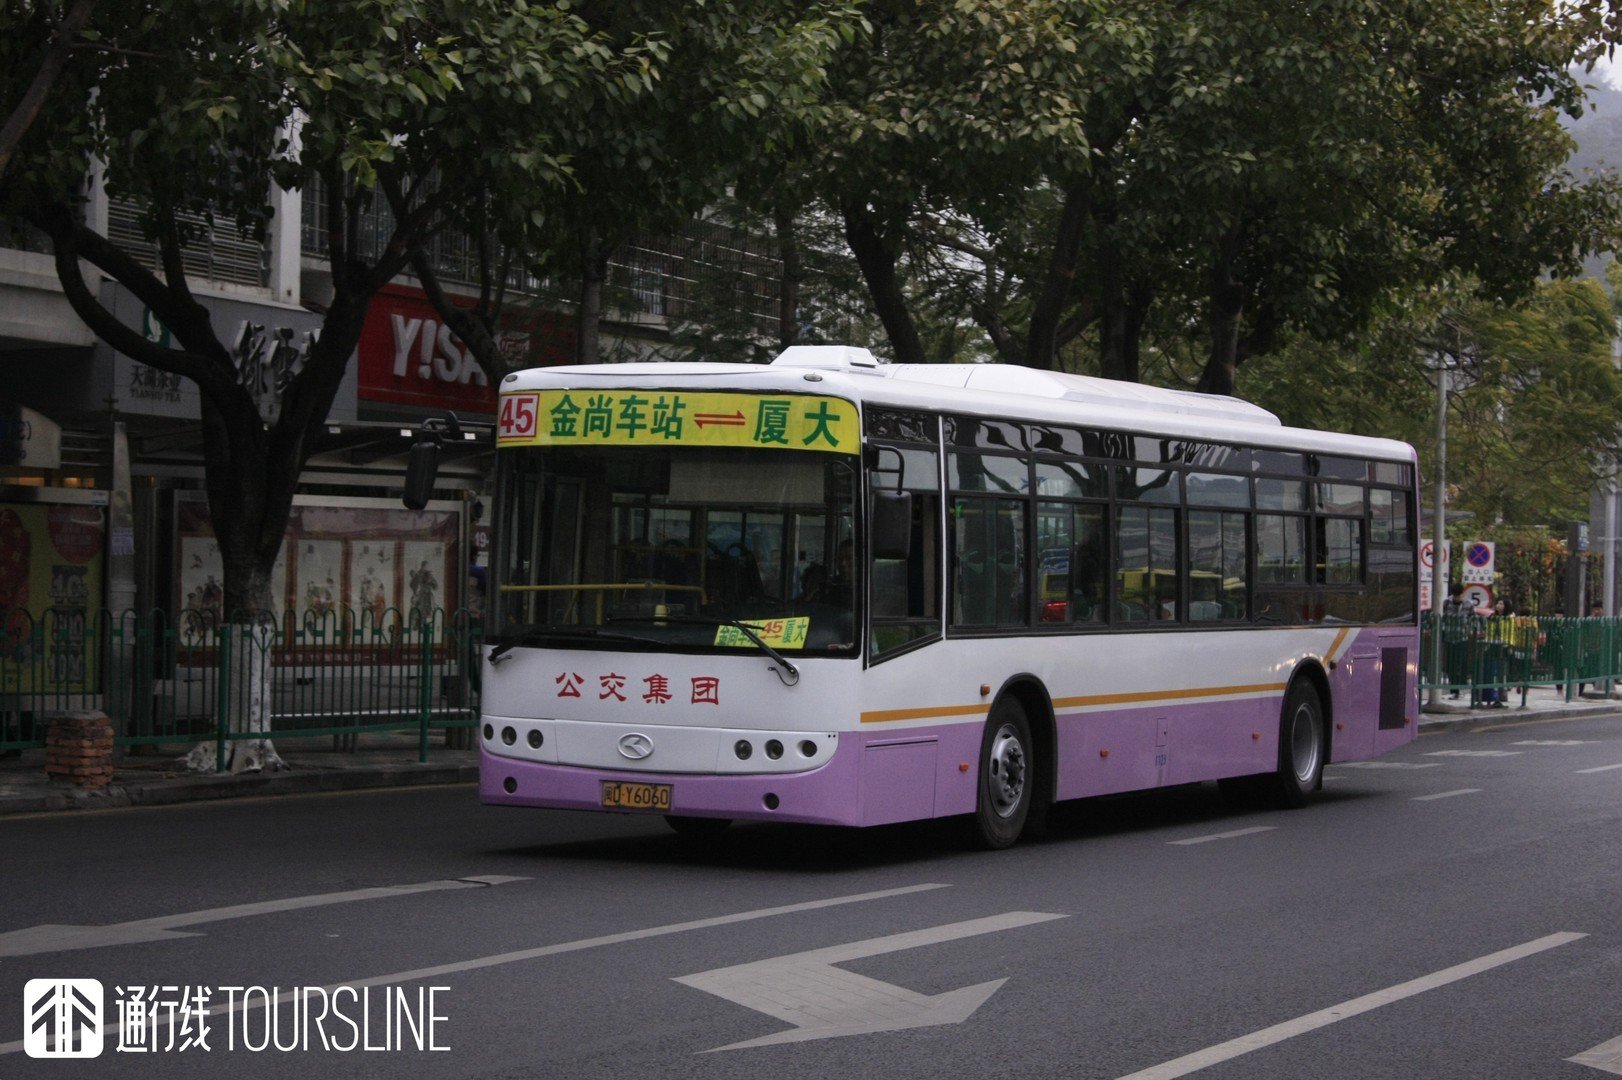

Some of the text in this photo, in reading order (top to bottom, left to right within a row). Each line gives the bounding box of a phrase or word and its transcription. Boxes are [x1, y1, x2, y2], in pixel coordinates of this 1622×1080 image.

[499, 393, 841, 447] 45 金尚车站 厦大
[1471, 592, 1480, 606] 5
[763, 620, 783, 633] 45
[555, 672, 720, 705] 公交集团
